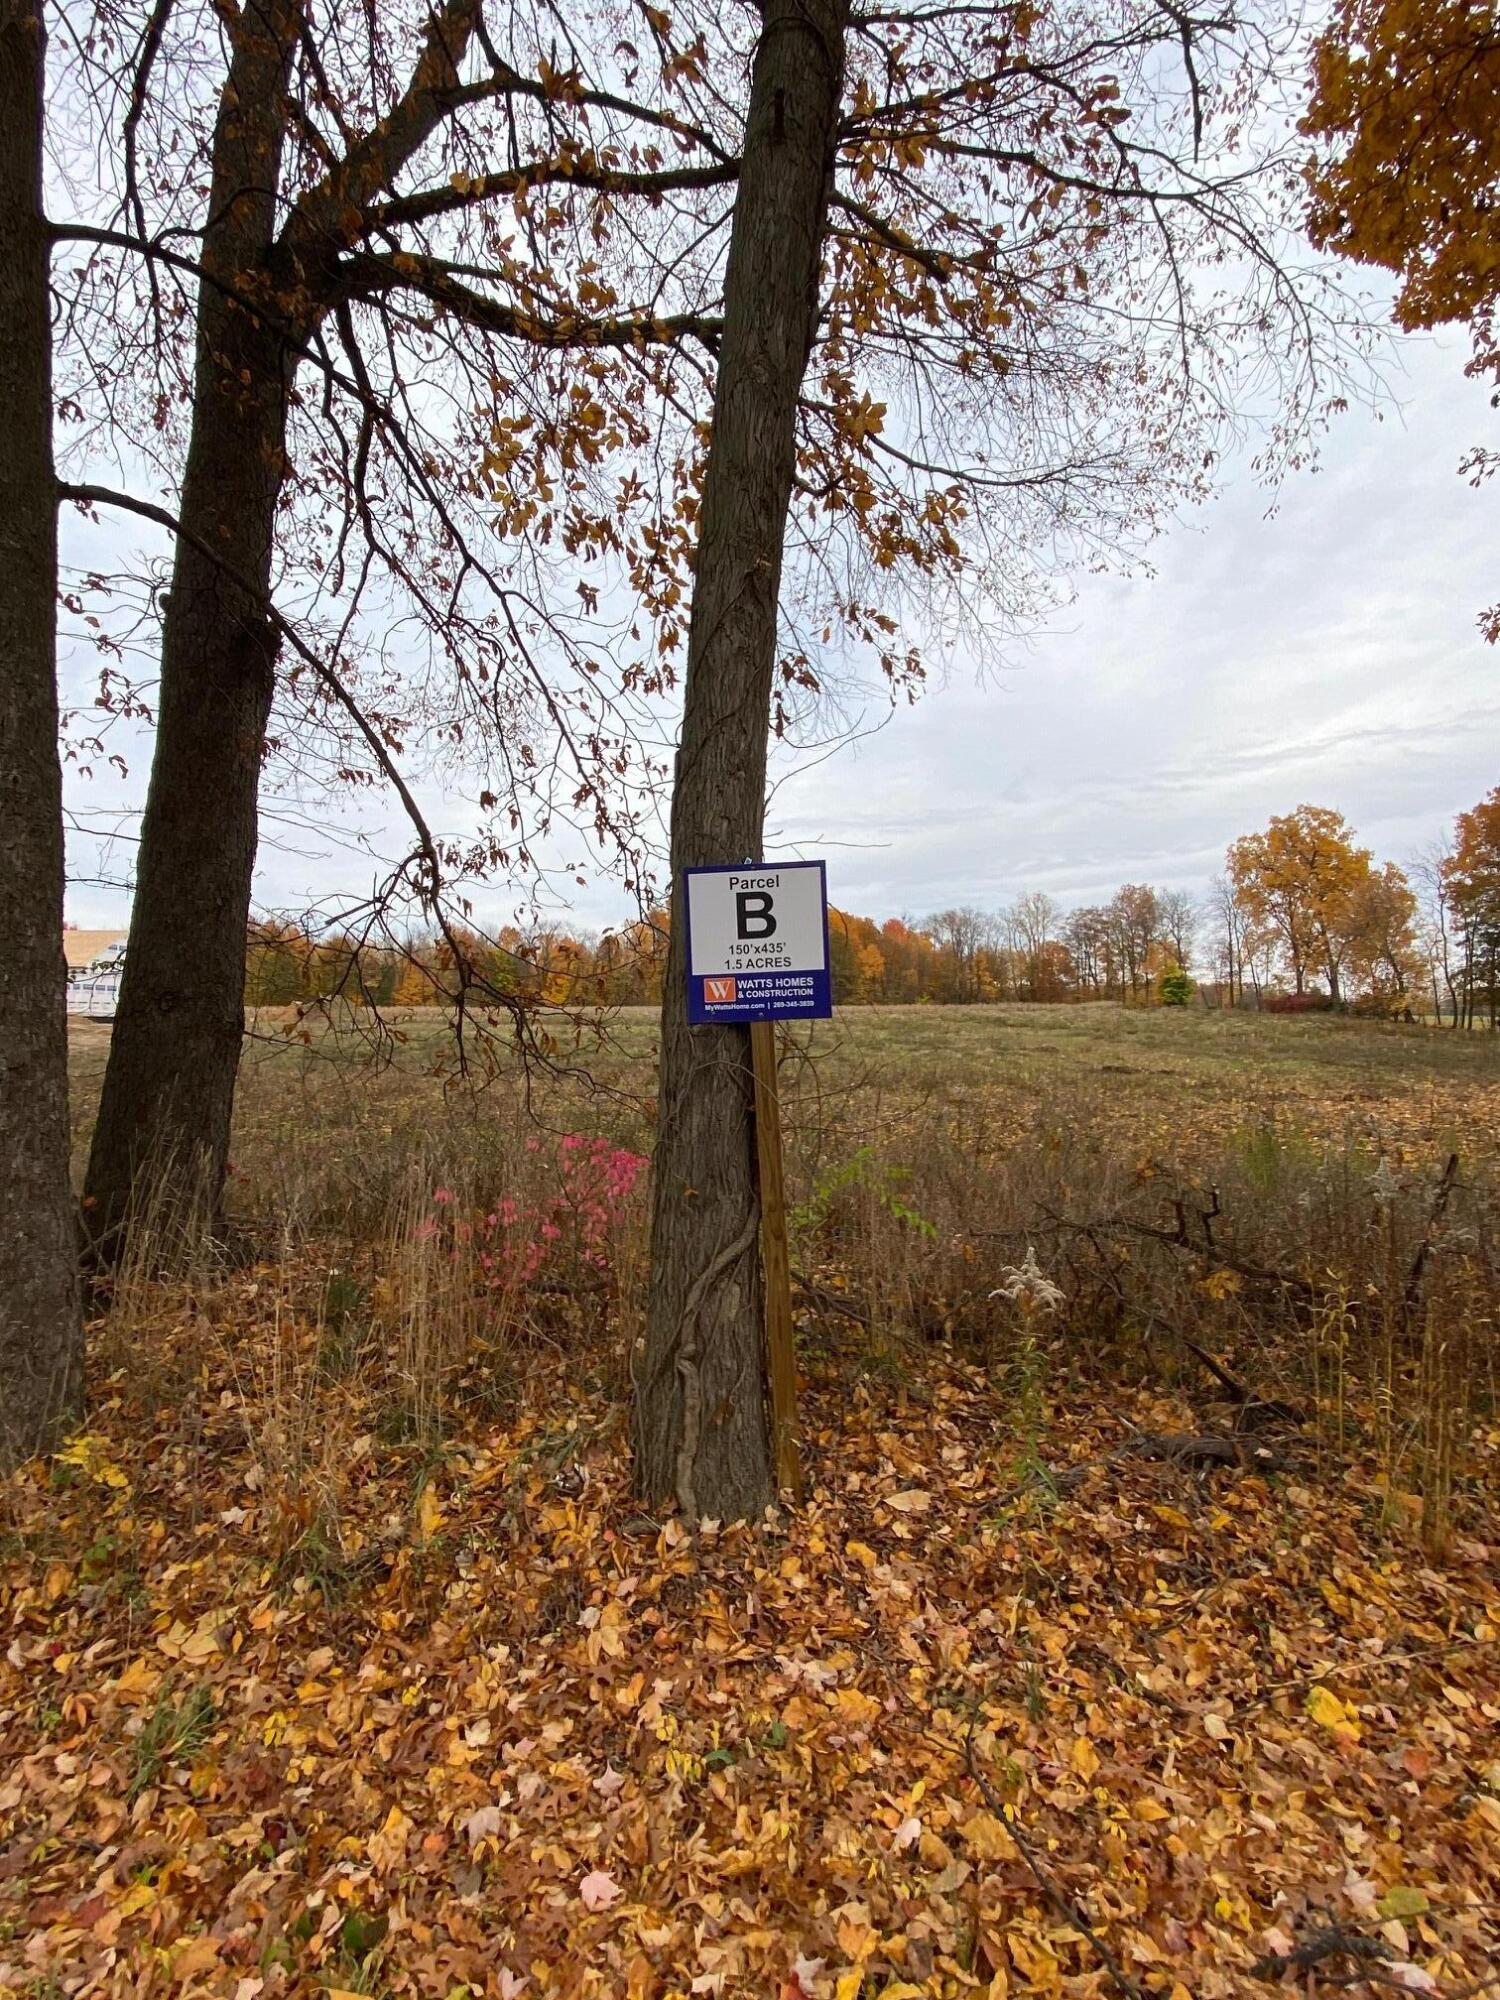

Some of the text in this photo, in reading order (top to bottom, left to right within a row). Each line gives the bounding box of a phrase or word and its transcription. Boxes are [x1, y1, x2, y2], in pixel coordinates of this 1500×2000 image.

[729, 875, 780, 890] Parcel
[736, 891, 777, 940] B
[729, 942, 786, 955] 150'x435'
[724, 956, 792, 970] 1.5 ACRES
[738, 977, 814, 989] WATTS HOMES
[746, 989, 813, 998] CONSTRUCTION
